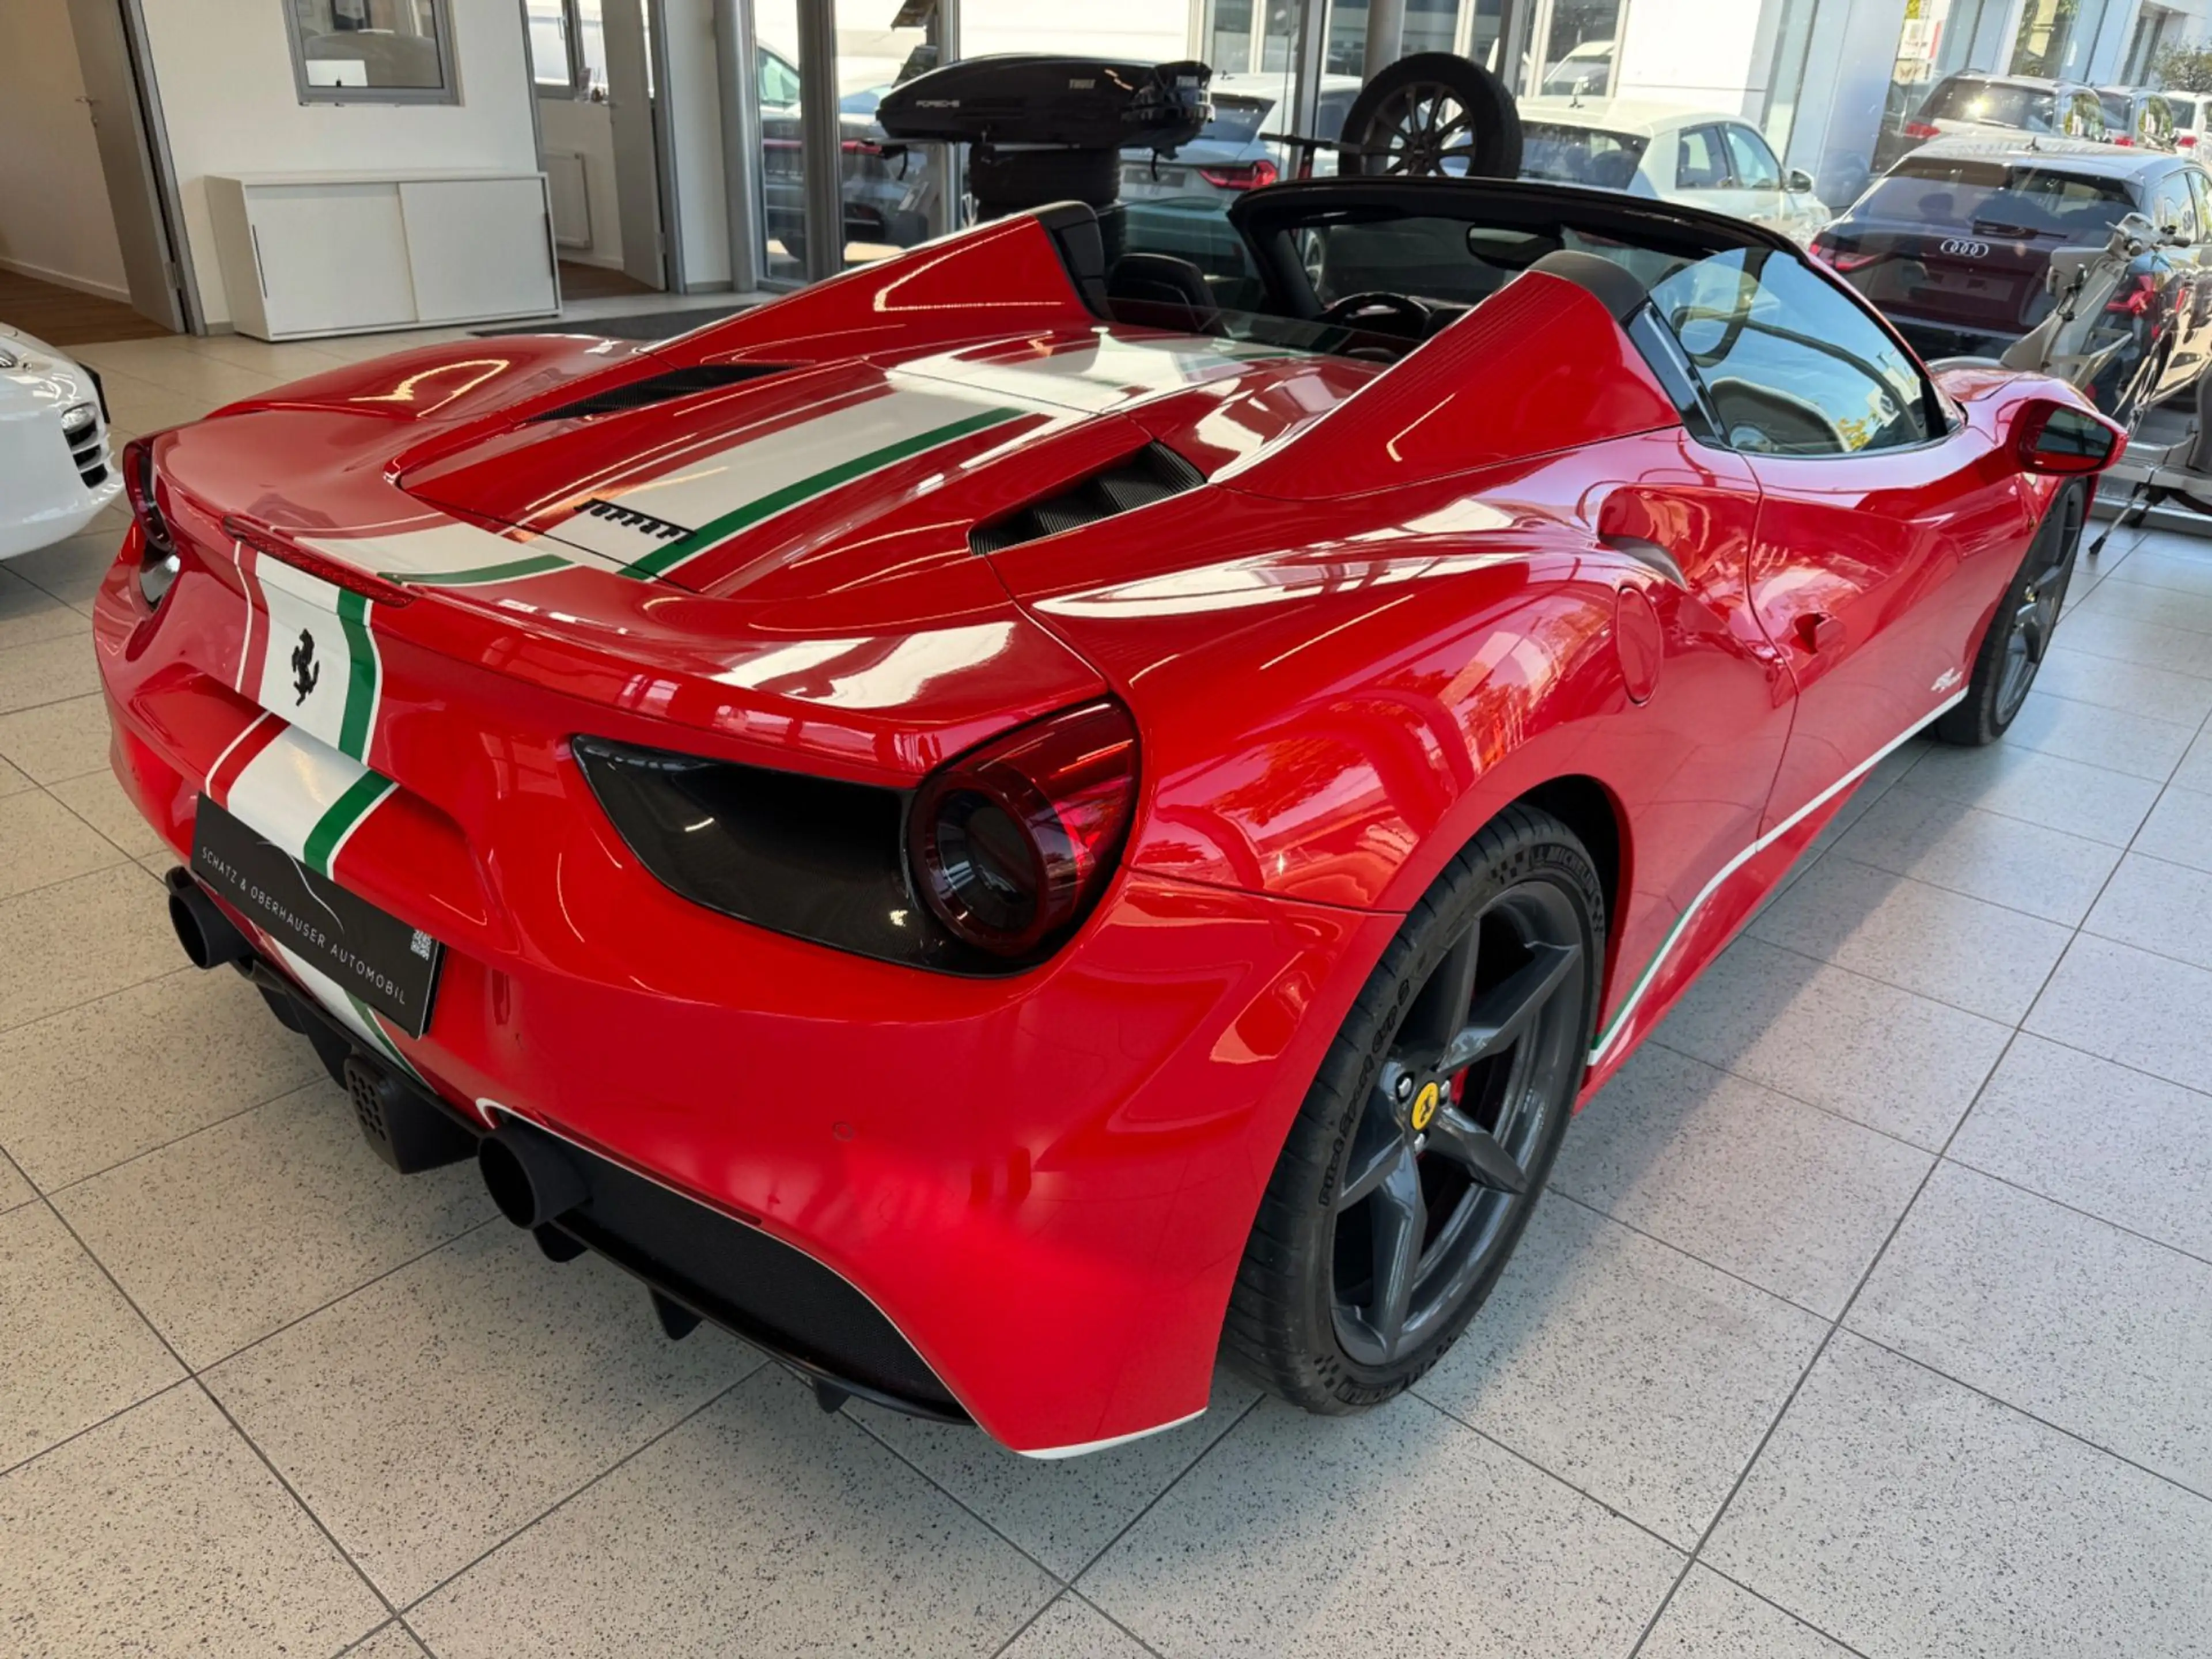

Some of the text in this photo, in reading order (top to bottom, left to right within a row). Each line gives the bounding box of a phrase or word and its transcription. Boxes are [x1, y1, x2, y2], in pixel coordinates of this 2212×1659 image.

[573, 498, 698, 546] Ferrari
[202, 846, 405, 1005] SCHATZ & OBERHAUSER AUTOMOBIL
